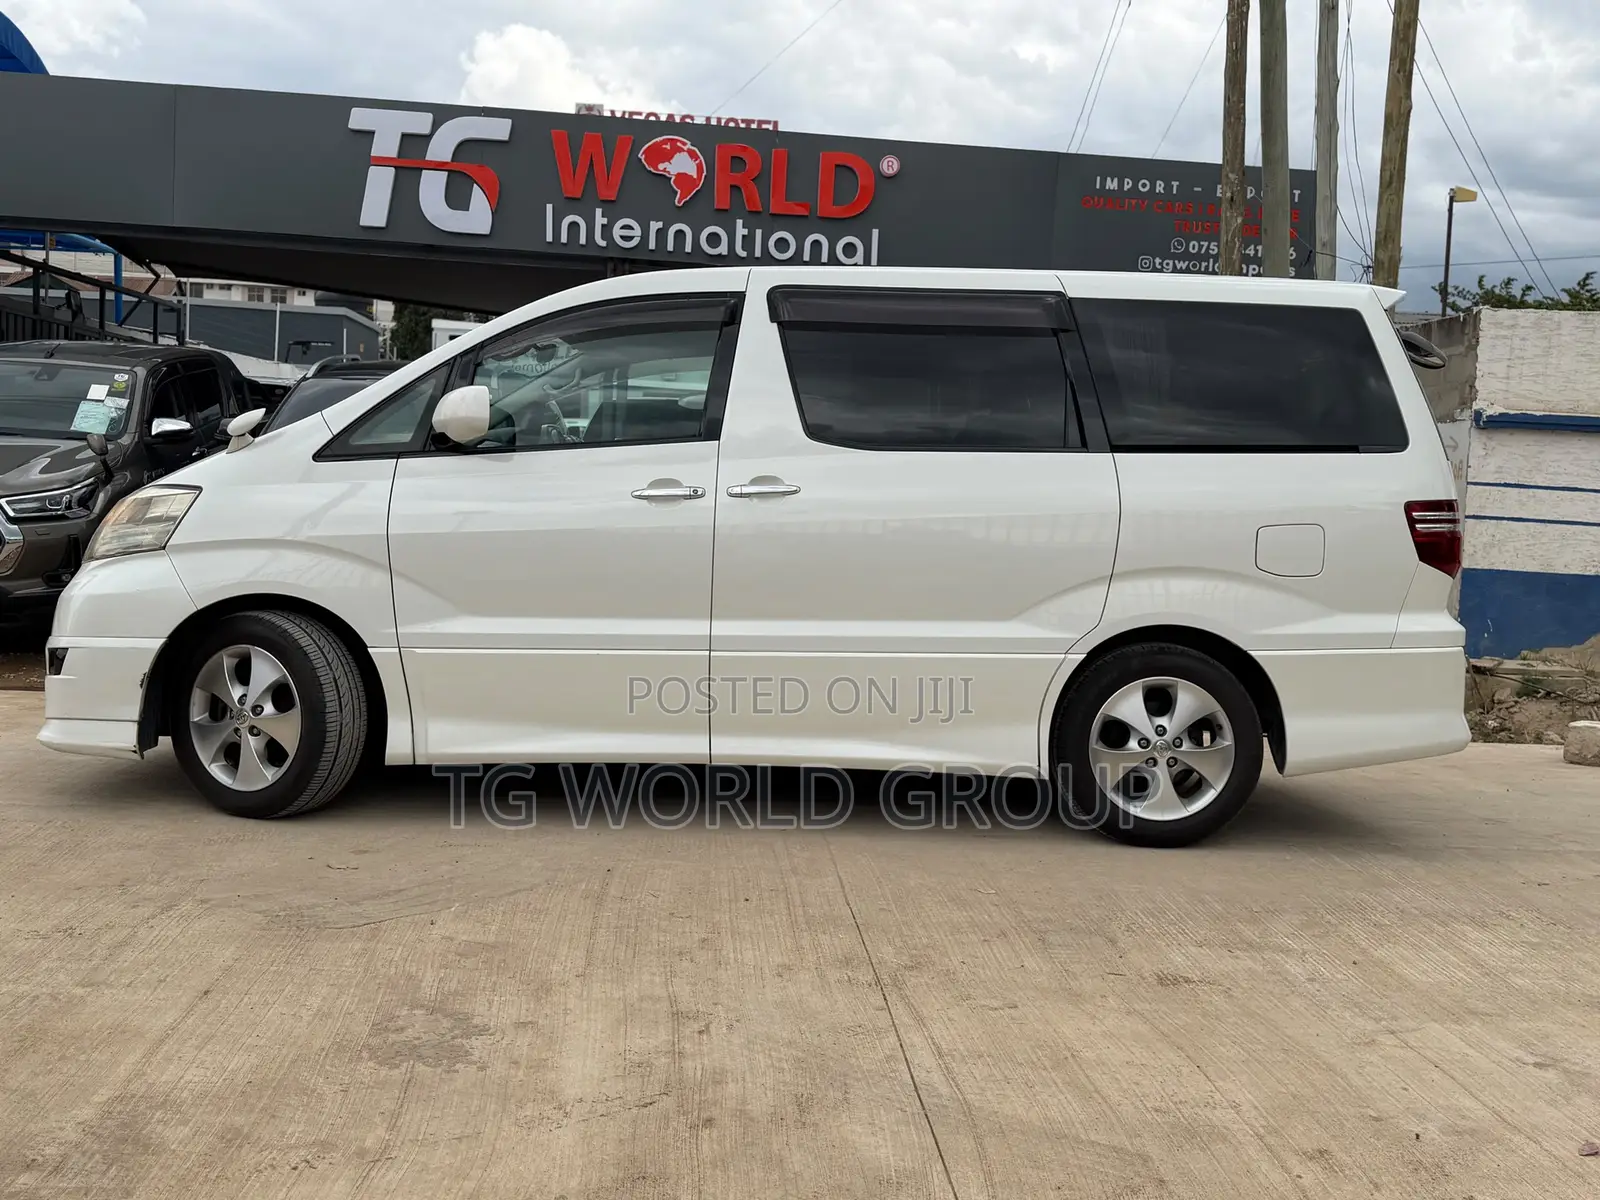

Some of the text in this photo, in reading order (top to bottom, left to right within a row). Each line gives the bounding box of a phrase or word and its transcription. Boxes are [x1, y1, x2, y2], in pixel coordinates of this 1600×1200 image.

[348, 107, 512, 235] TG
[1095, 175, 1180, 195] IMPORT
[1081, 196, 1148, 212] QUALITY
[1152, 200, 1194, 215] CARS
[545, 203, 879, 265] International
